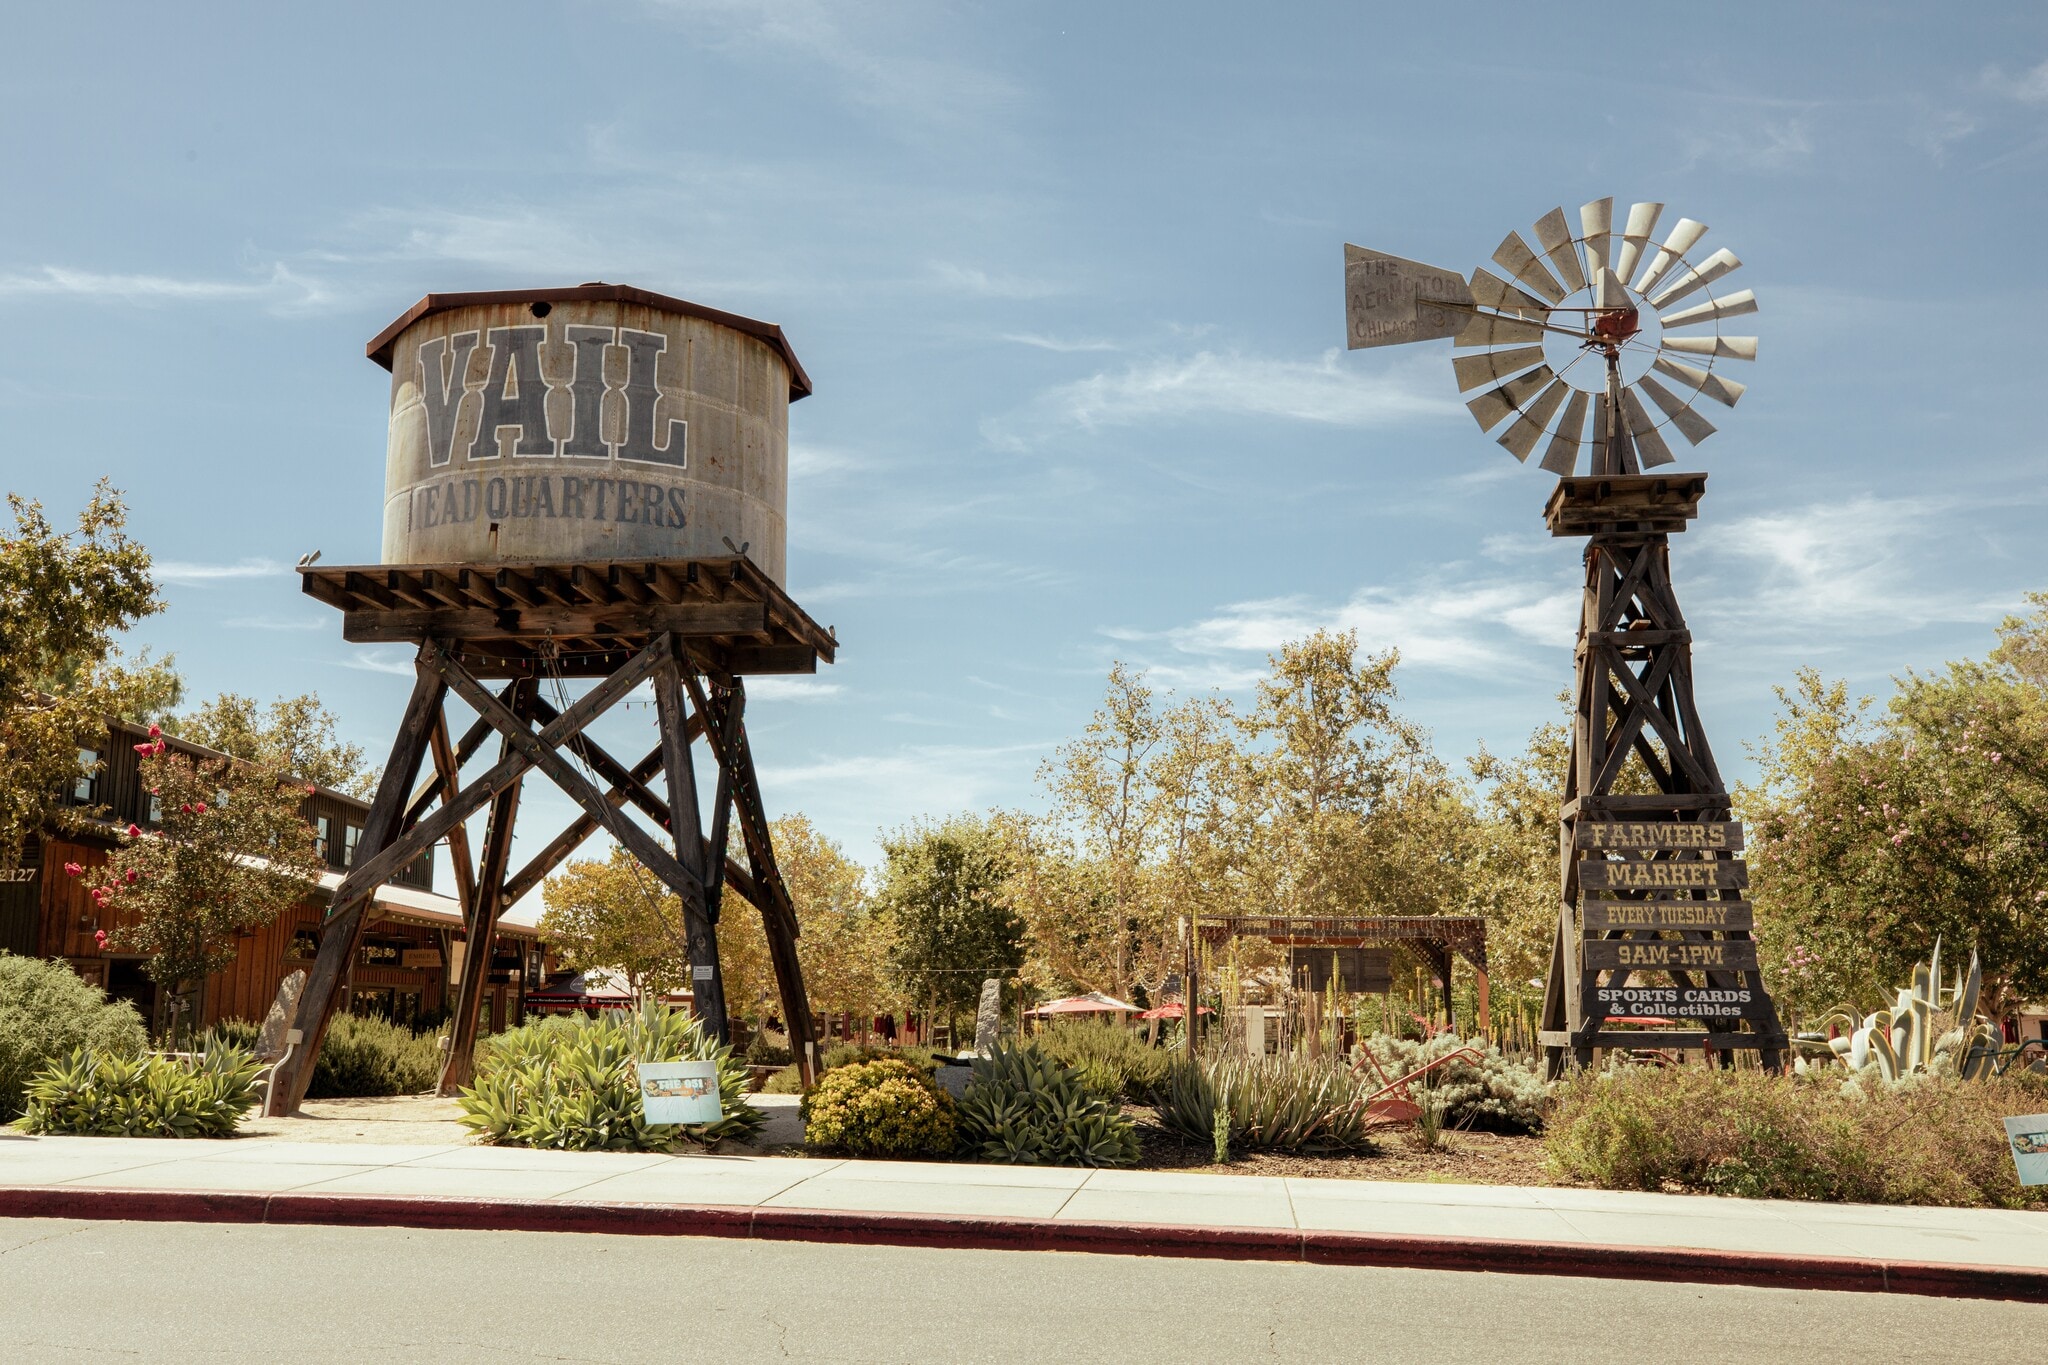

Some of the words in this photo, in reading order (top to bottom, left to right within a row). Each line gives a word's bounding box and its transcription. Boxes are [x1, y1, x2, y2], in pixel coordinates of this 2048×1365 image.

[1361, 257, 1398, 276] THE
[418, 324, 688, 469] VAIL
[1591, 824, 1727, 848] FARMERS
[1606, 862, 1719, 886] MARKET
[1607, 906, 1655, 925] EVERY
[1658, 906, 1728, 925] TUESDAY
[1618, 945, 1724, 965] 9AM-1PM
[1598, 989, 1678, 1002] SPORTS
[1684, 990, 1751, 1003] CARDS
[1609, 1003, 1625, 1015] &
[1630, 1003, 1742, 1016] Collectibles
